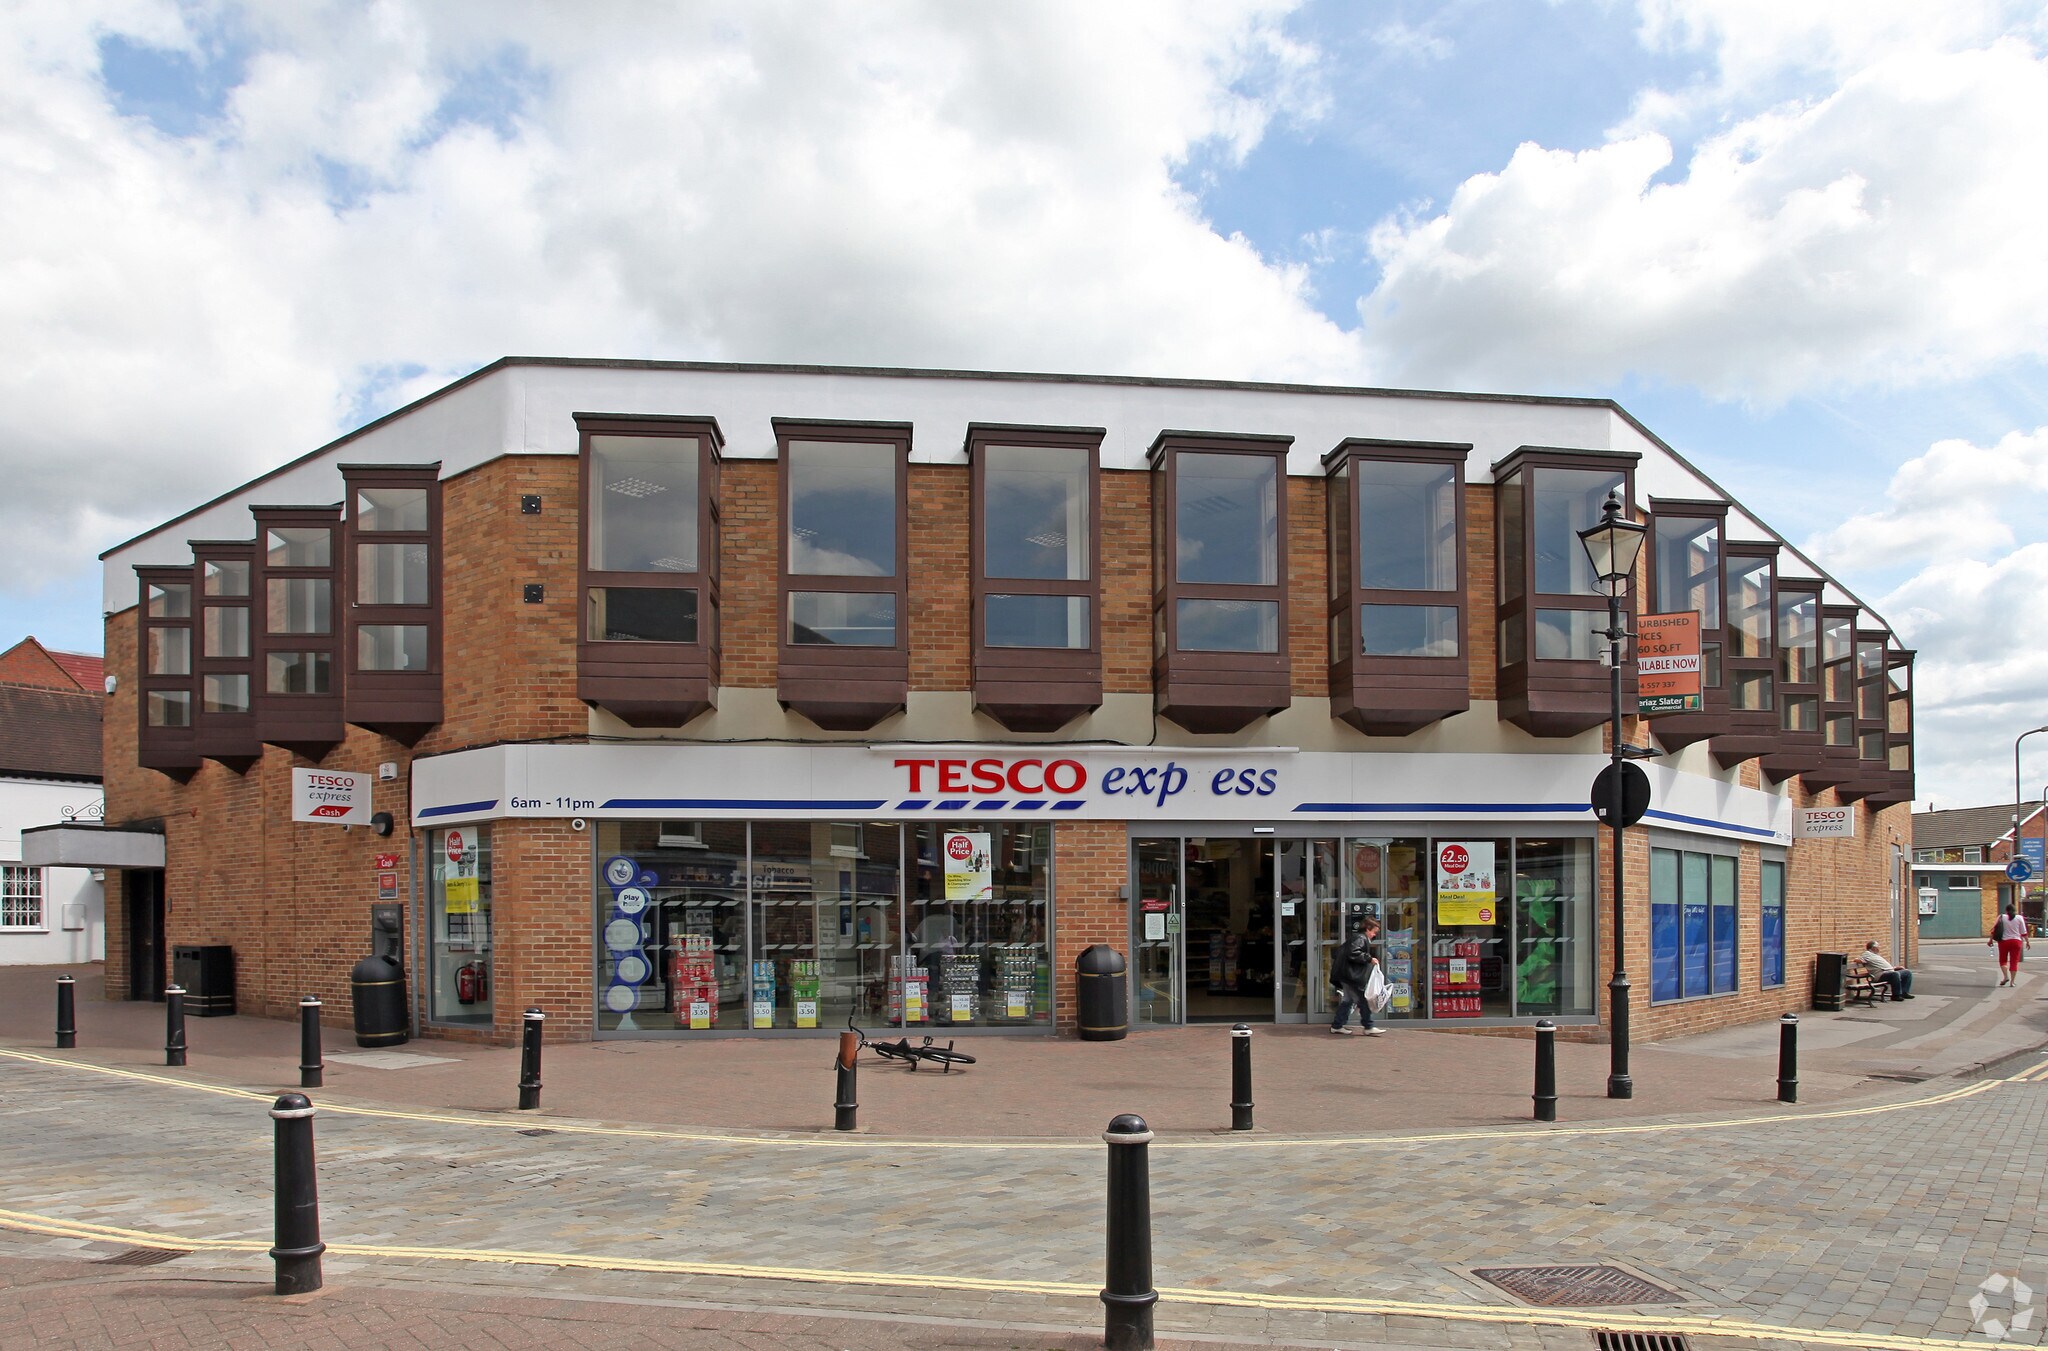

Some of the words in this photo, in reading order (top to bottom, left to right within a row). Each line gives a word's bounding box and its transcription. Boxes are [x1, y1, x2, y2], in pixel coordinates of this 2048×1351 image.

[1638, 618, 1689, 628] URBISHED
[1638, 645, 1650, 653] 60
[1638, 659, 1670, 671] AILABLE
[1673, 658, 1697, 669] NOW
[1638, 699, 1657, 707] eriaz
[1659, 697, 1683, 706] Slater
[308, 774, 355, 787] TESCO
[894, 758, 1088, 794] TESCO
[309, 791, 352, 802] express
[511, 797, 541, 809] 6am
[556, 797, 595, 811] 11pm
[319, 808, 340, 817] Cash
[1805, 811, 1846, 820] TESCO
[1806, 824, 1843, 834] express
[448, 837, 461, 846] Half
[951, 841, 969, 849] Half
[448, 847, 462, 855] Price
[1441, 850, 1468, 863] £2.50
[762, 864, 795, 874] Tobacco
[623, 894, 640, 902] Play
